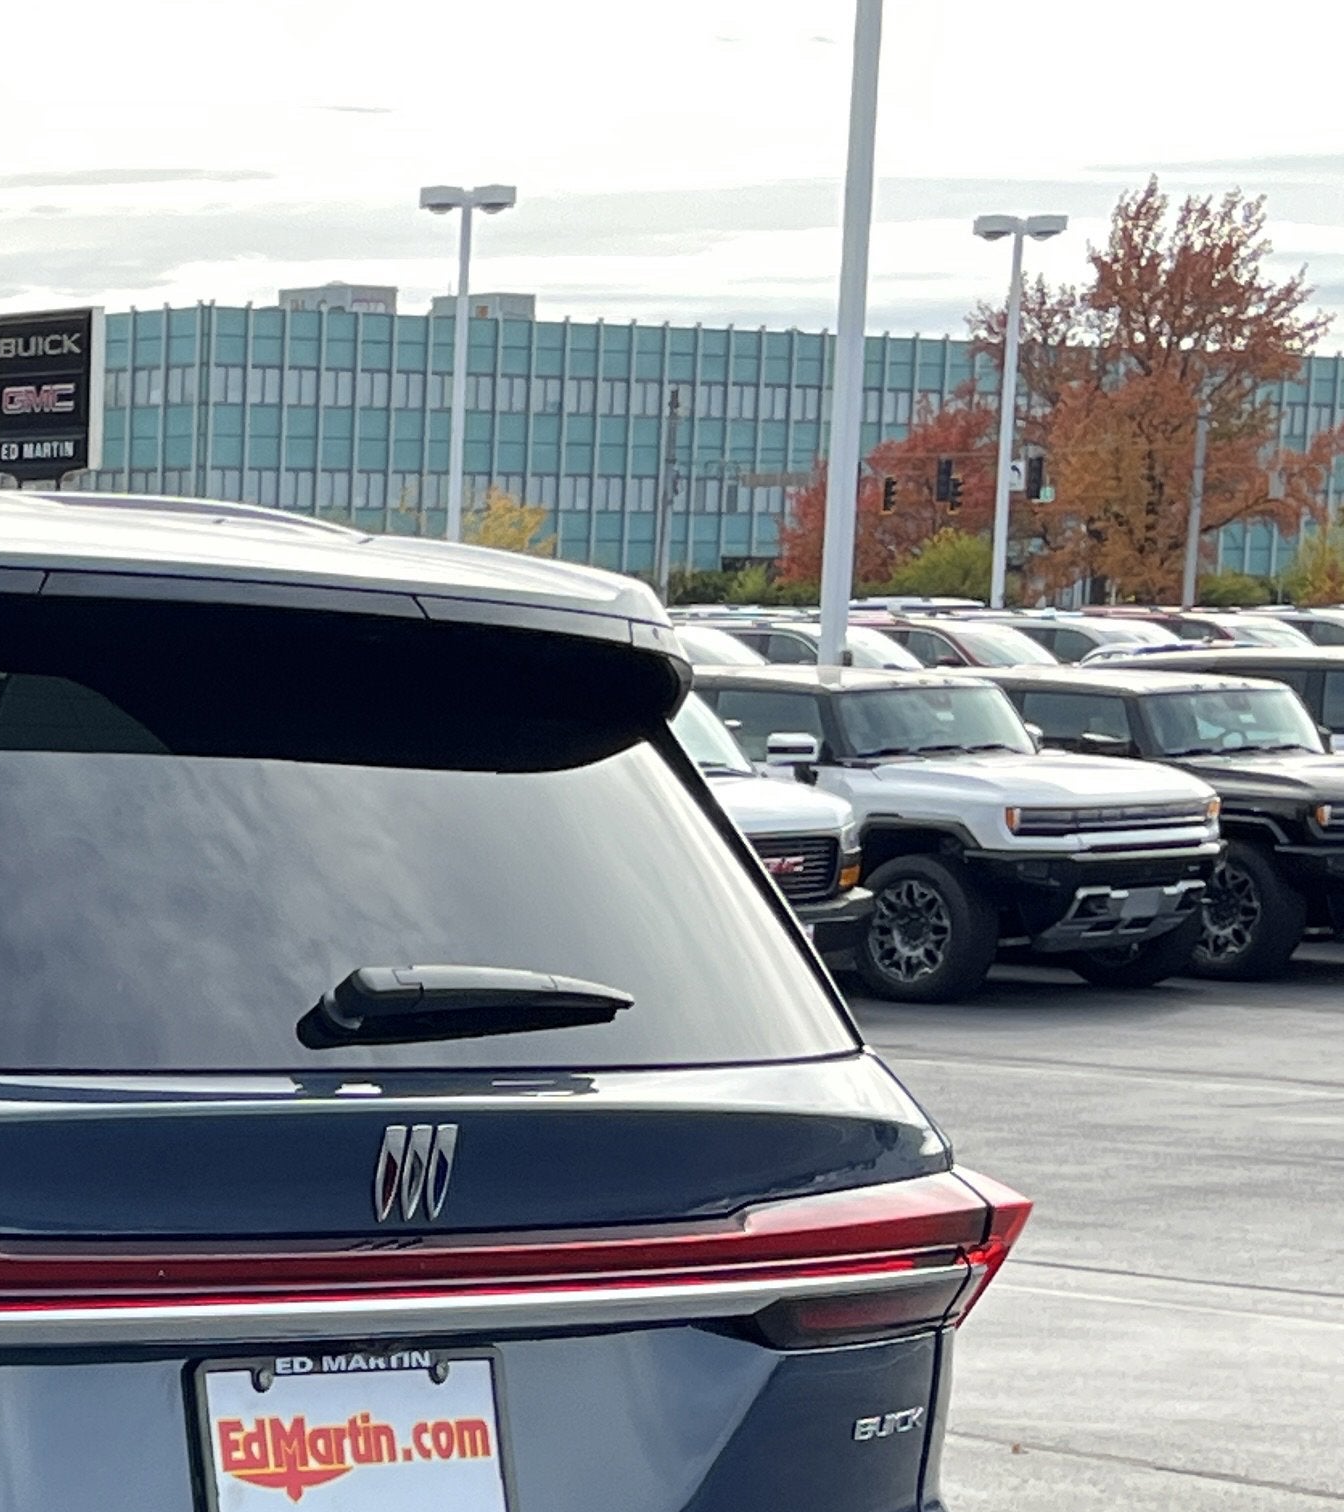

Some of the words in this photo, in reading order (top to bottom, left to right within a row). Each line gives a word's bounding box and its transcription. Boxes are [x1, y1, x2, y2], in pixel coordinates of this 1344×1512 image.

[2, 383, 75, 415] GMC
[0, 443, 19, 461] ED
[22, 441, 74, 460] MARTIN
[275, 1355, 313, 1375] ED
[322, 1350, 432, 1372] MARTIN
[853, 1406, 924, 1441] BUICK
[217, 1411, 492, 1480] EdMartin.com
